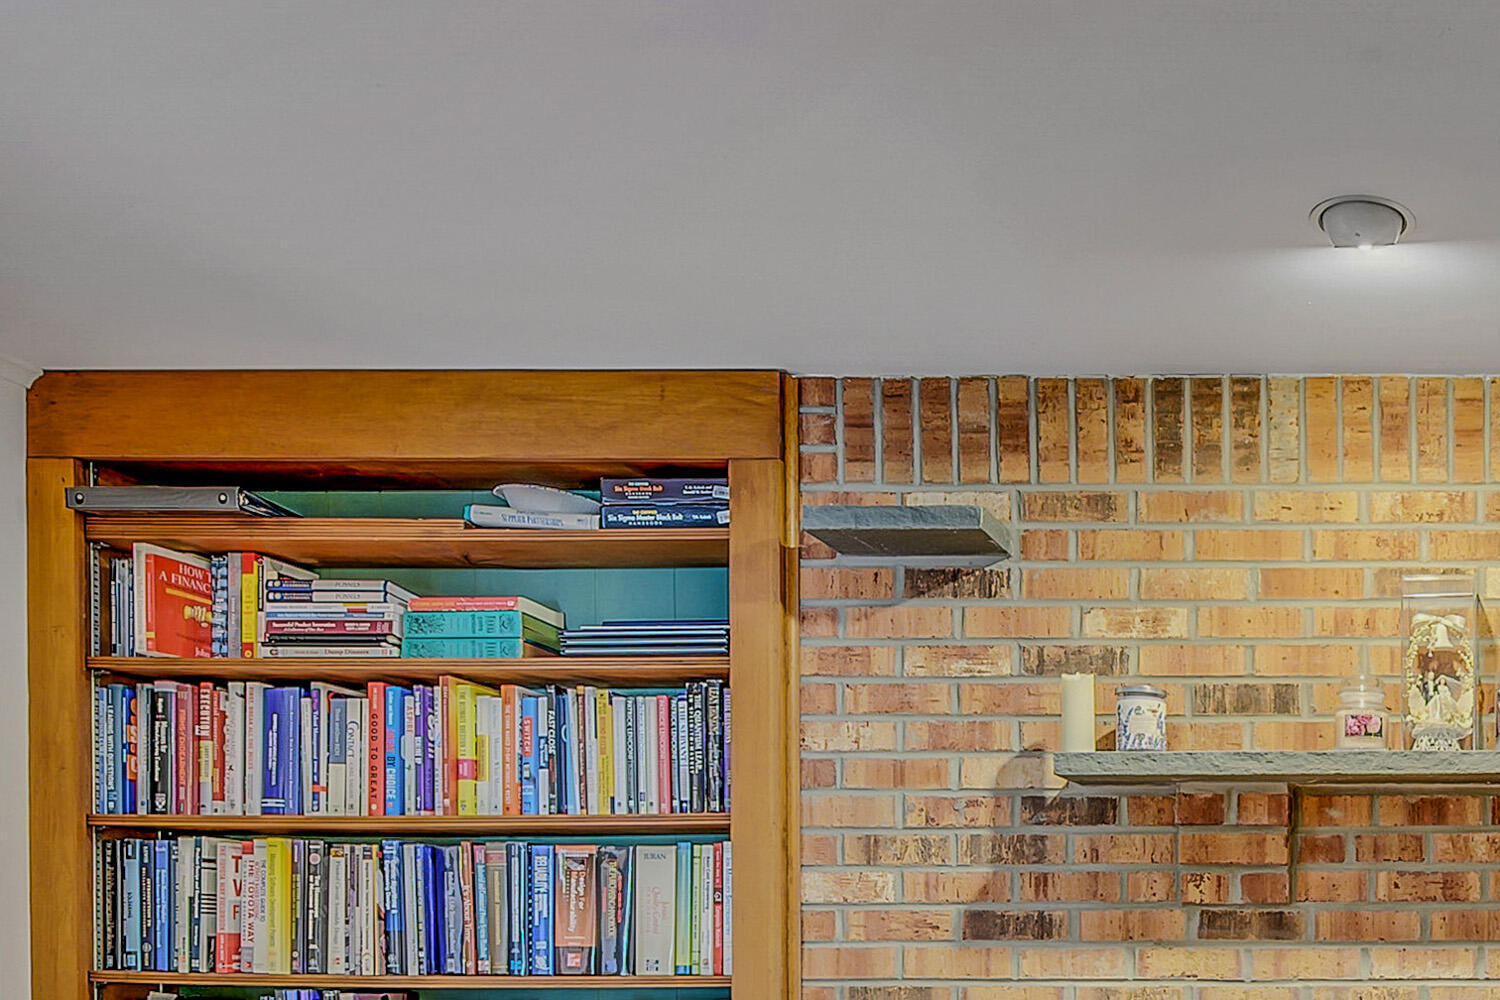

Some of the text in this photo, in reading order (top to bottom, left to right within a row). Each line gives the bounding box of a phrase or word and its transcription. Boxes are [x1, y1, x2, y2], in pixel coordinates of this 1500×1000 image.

[159, 571, 168, 581] A
[178, 563, 205, 580] HOW
[199, 688, 212, 737] EXECUTION
[406, 705, 414, 734] ASPIRE
[694, 694, 702, 750] THE QUANTUM
[523, 719, 531, 753] SWITCH
[371, 747, 378, 760] TO
[386, 756, 396, 767] BY
[386, 768, 396, 800] CHOICE
[534, 855, 548, 893] RELIABILITY
[577, 871, 586, 897] Design
[463, 899, 471, 922] About
[464, 924, 472, 941] Time
